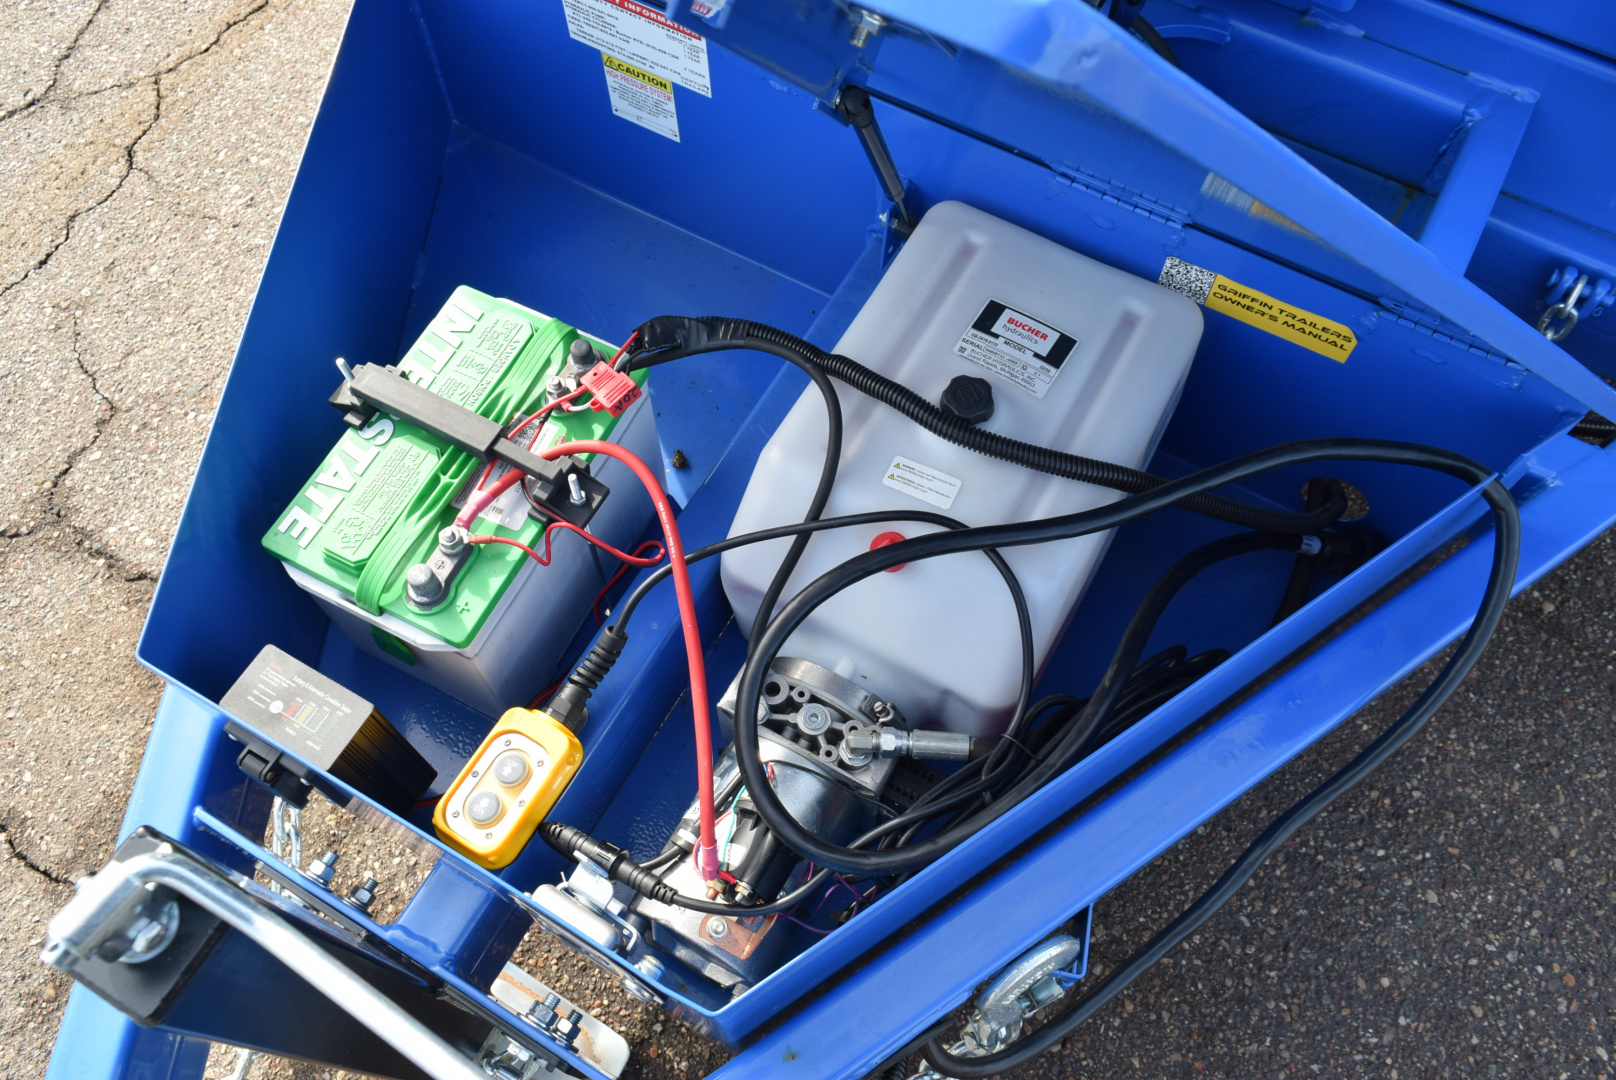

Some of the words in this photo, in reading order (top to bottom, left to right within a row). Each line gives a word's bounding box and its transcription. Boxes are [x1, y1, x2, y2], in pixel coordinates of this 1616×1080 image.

[617, 63, 668, 90] CAUTION
[620, 74, 649, 93] PRESSURE
[1213, 292, 1279, 323] OWNER'S
[1282, 320, 1348, 352] MANUAL
[1217, 283, 1274, 311] GRIFFIN
[1278, 308, 1352, 343] TRAILERS
[1002, 324, 1038, 345] hydraulics
[1007, 317, 1048, 341] BUCHER
[962, 338, 983, 351] SERIAL
[1003, 340, 1026, 355] MODEL
[967, 352, 982, 362] Grand
[1000, 367, 1020, 380] Michigan
[970, 349, 992, 362] BUCHER
[614, 387, 638, 412] 20A
[506, 759, 518, 768] UP
[473, 804, 485, 815] DN
